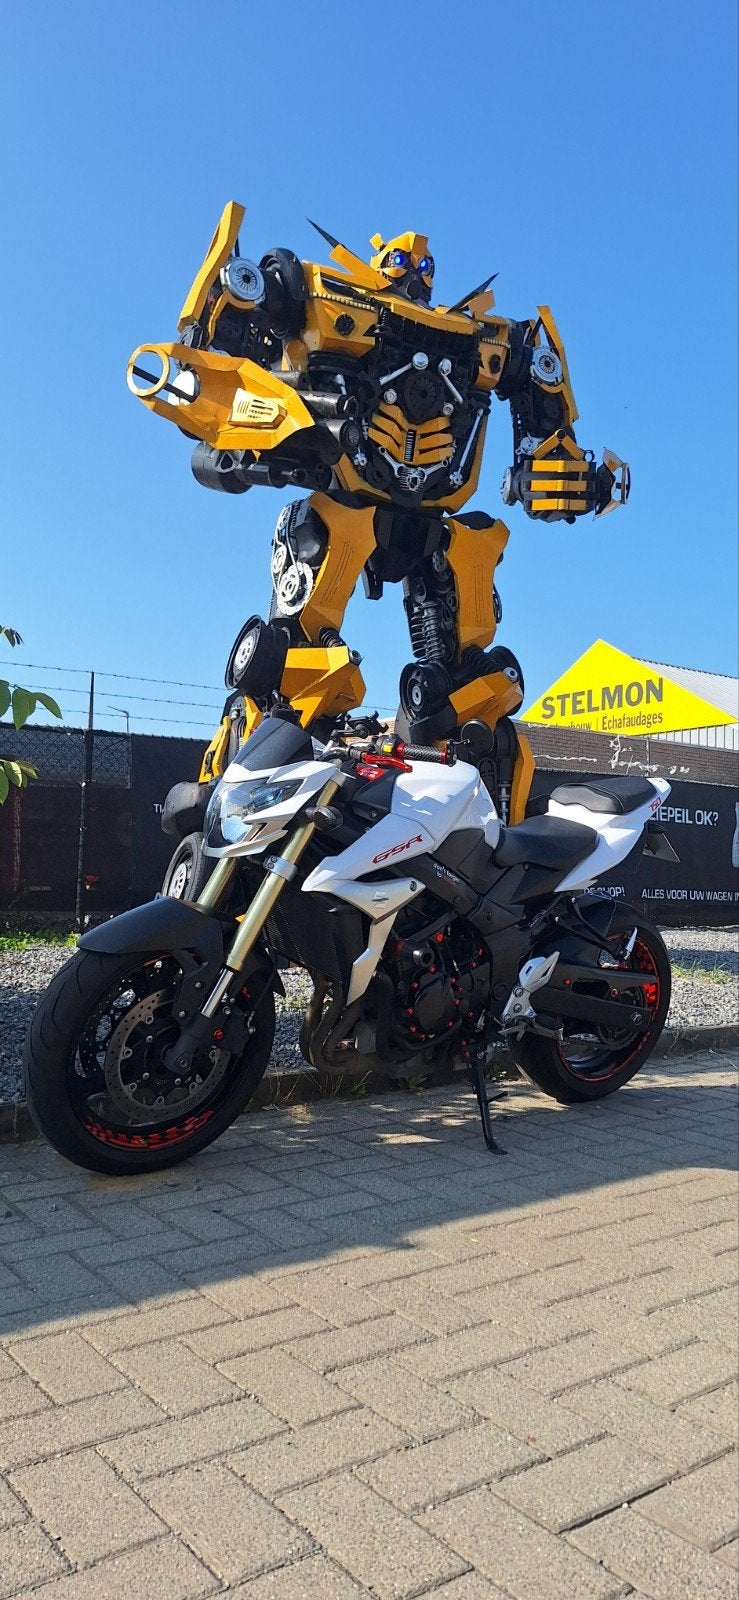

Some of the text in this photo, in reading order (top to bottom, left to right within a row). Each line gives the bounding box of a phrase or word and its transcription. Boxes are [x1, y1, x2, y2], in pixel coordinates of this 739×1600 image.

[541, 677, 664, 719] STELMON
[648, 797, 662, 813] 750
[649, 806, 719, 827] IEPEIL OK?
[372, 834, 423, 864] GSR
[641, 888, 664, 899] ALLES
[666, 889, 688, 900] VOOR
[689, 890, 704, 901] UW
[705, 891, 733, 902] WAGEN
